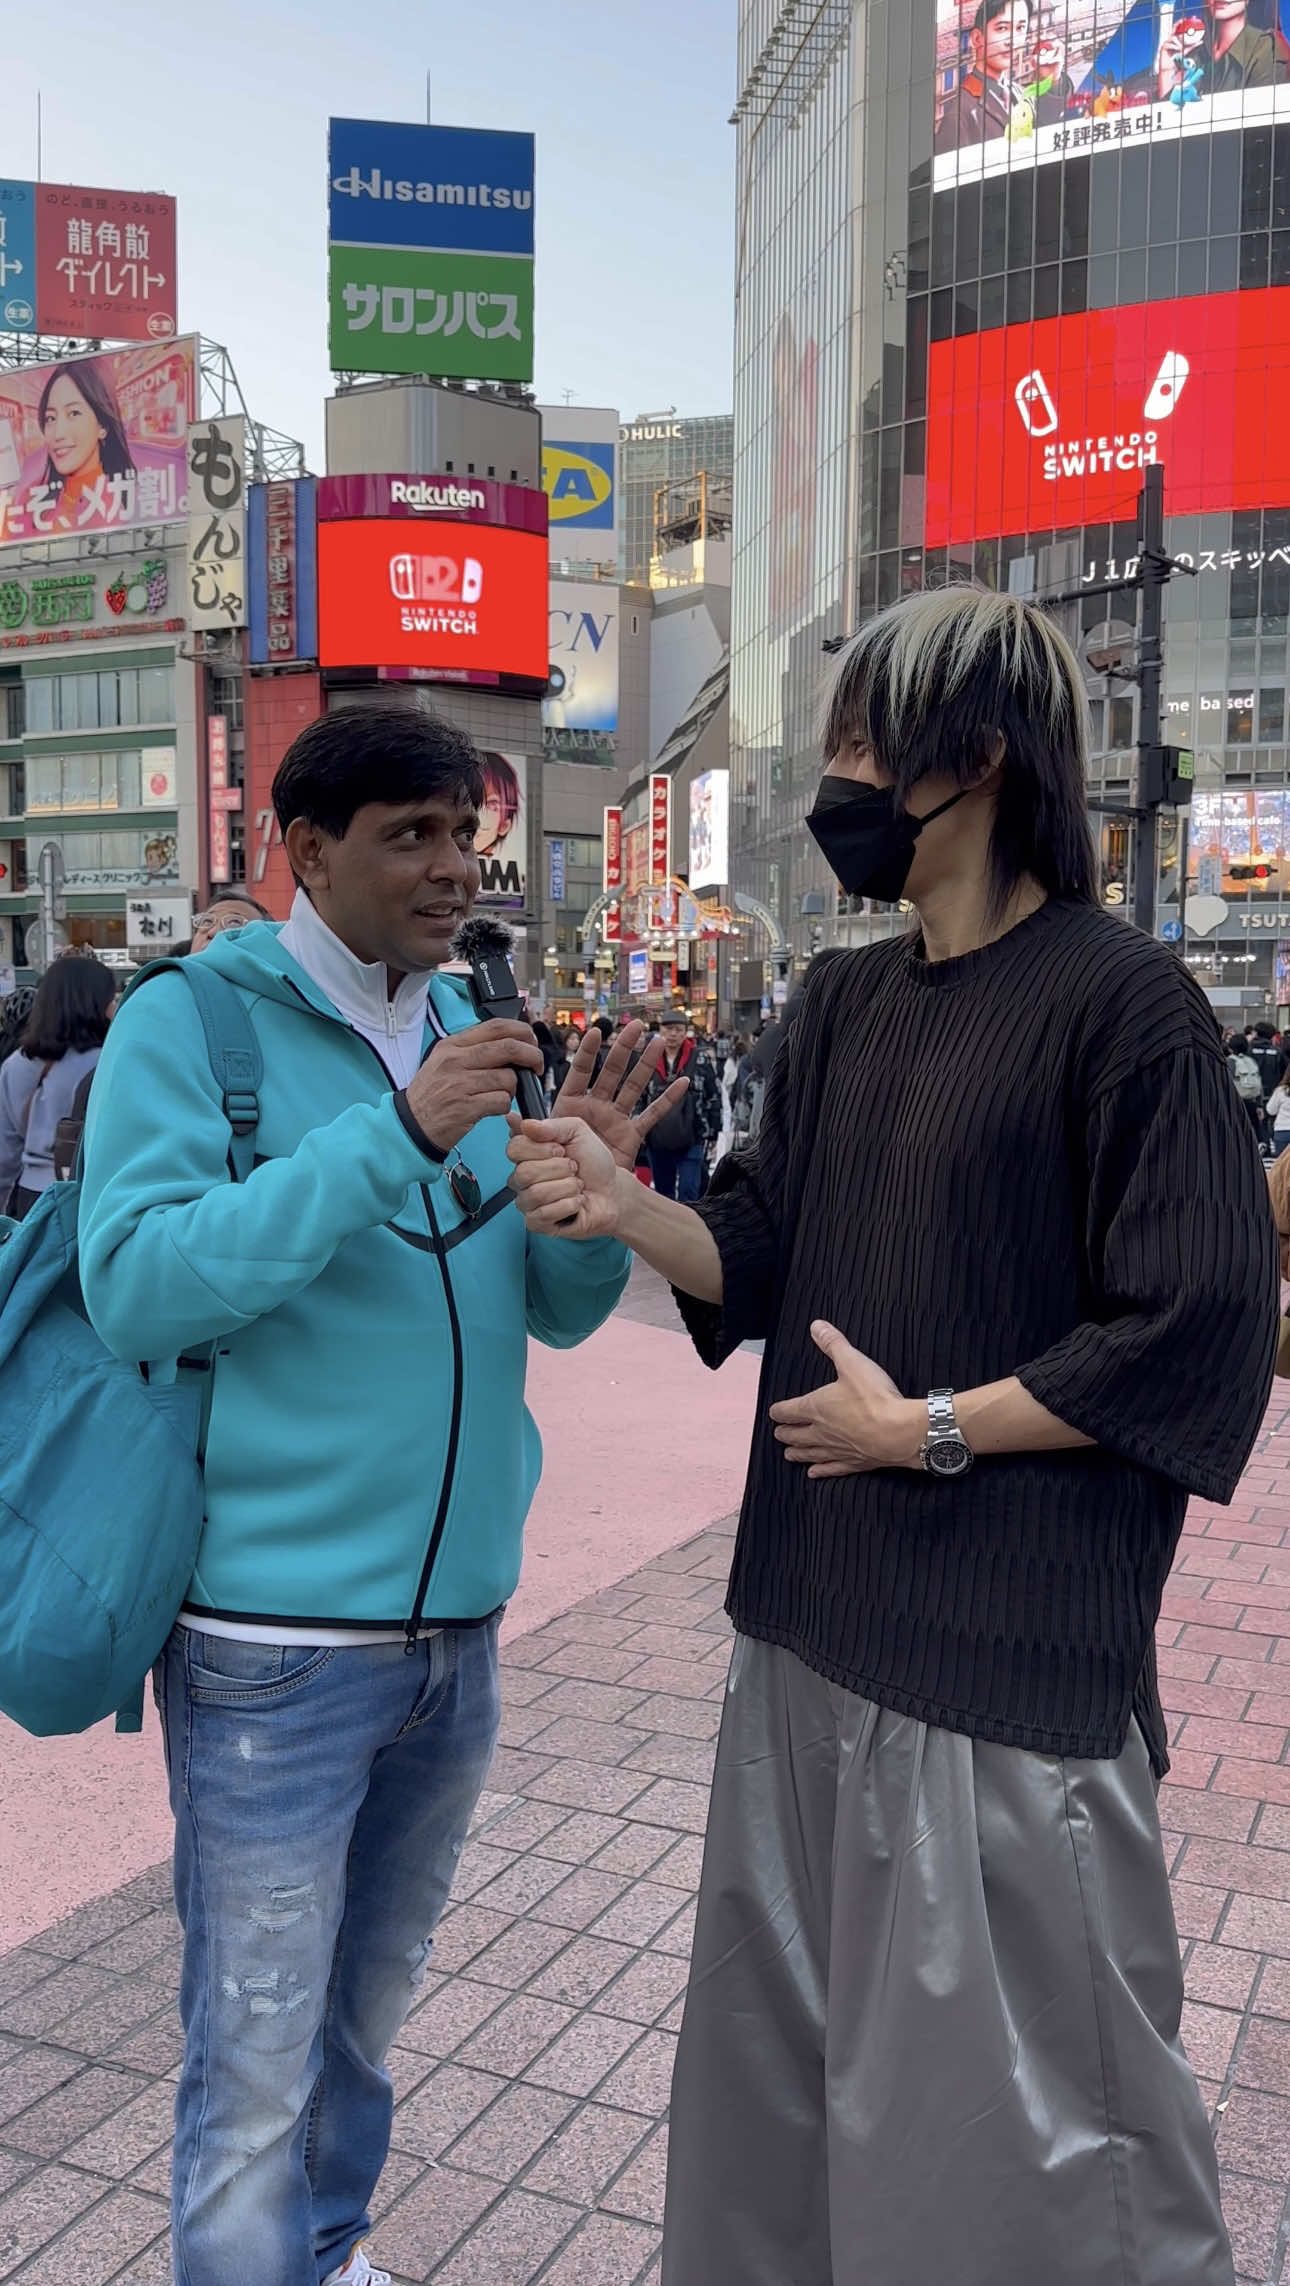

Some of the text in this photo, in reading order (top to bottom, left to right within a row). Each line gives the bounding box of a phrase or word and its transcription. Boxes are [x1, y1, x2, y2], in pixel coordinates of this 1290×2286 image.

[333, 167, 532, 210] Hisamitsu
[66, 217, 150, 260] 龍角散
[56, 257, 166, 300] ダイレクト
[342, 282, 522, 342] サロンパス
[631, 424, 681, 441] HULIC
[1044, 431, 1158, 457] NINTENDO
[1043, 446, 1163, 481] SWITCH
[391, 480, 485, 511] Rakuten
[190, 423, 243, 622] もんじゃ
[401, 607, 477, 620] NINTENDO
[401, 618, 480, 635] SWITCH
[1105, 881, 1125, 905] S
[1239, 910, 1290, 929] TSUT
